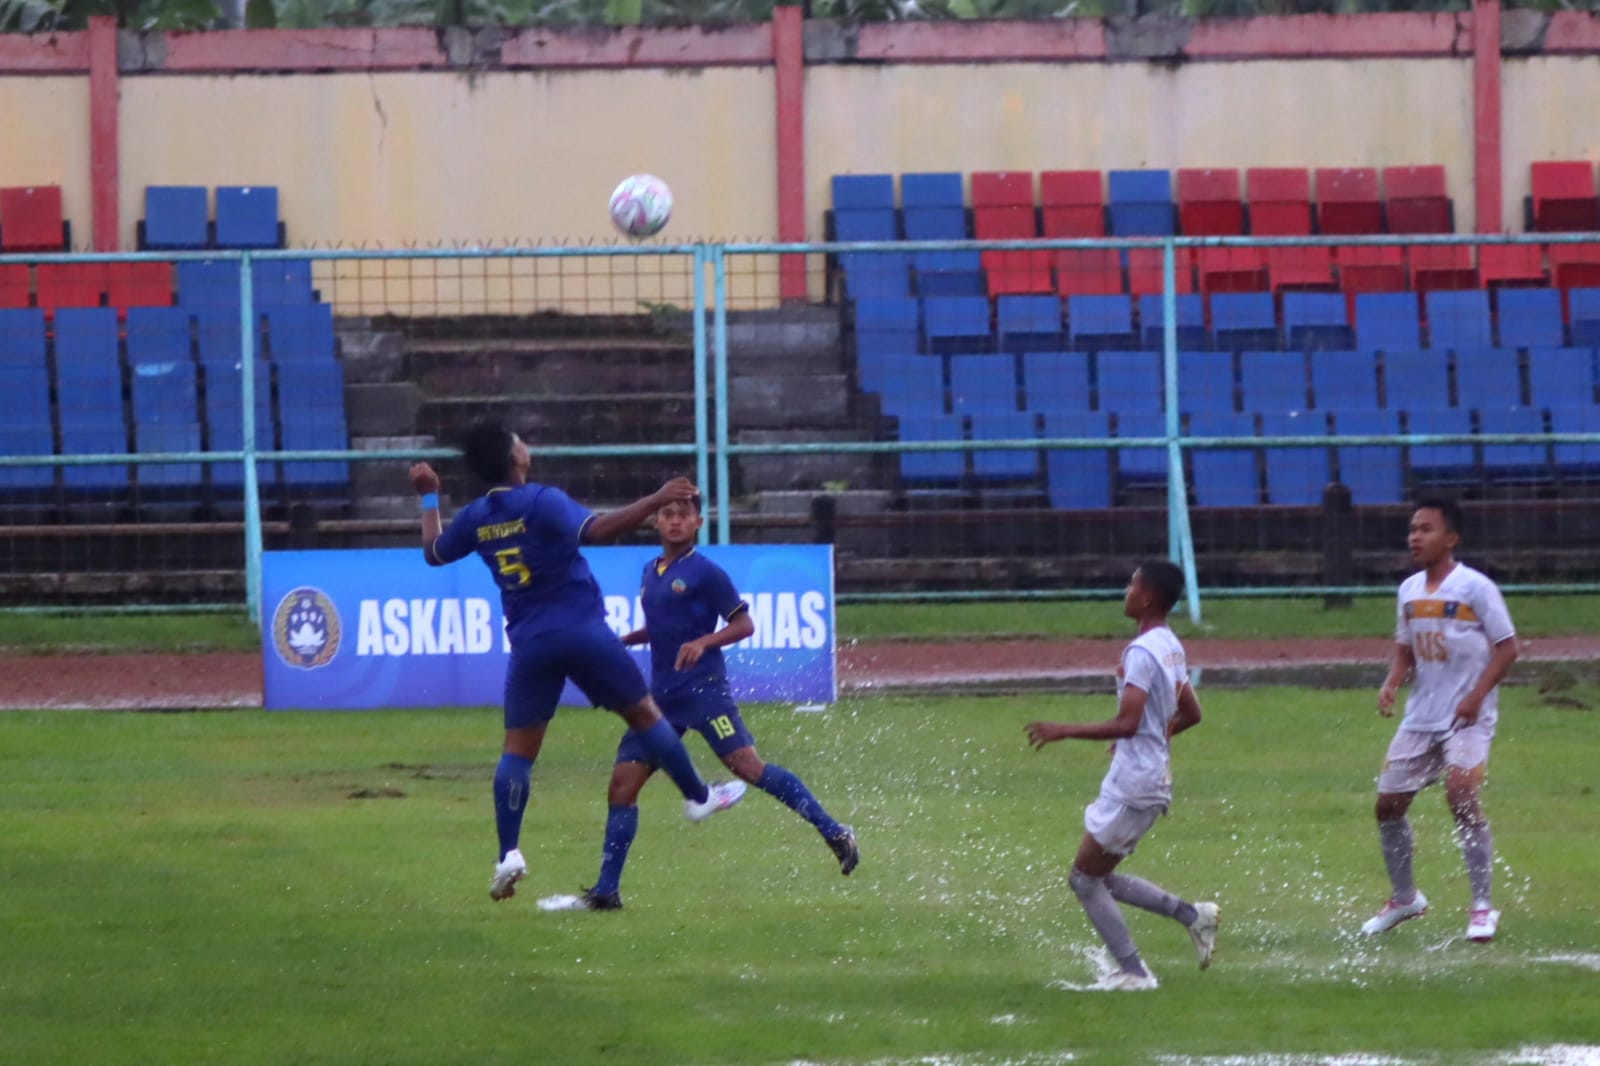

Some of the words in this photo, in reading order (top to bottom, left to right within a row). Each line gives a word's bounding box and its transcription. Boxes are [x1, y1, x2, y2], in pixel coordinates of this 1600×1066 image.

[495, 549, 530, 586] 5
[356, 597, 493, 656] ASKAB
[710, 715, 736, 740] 19
